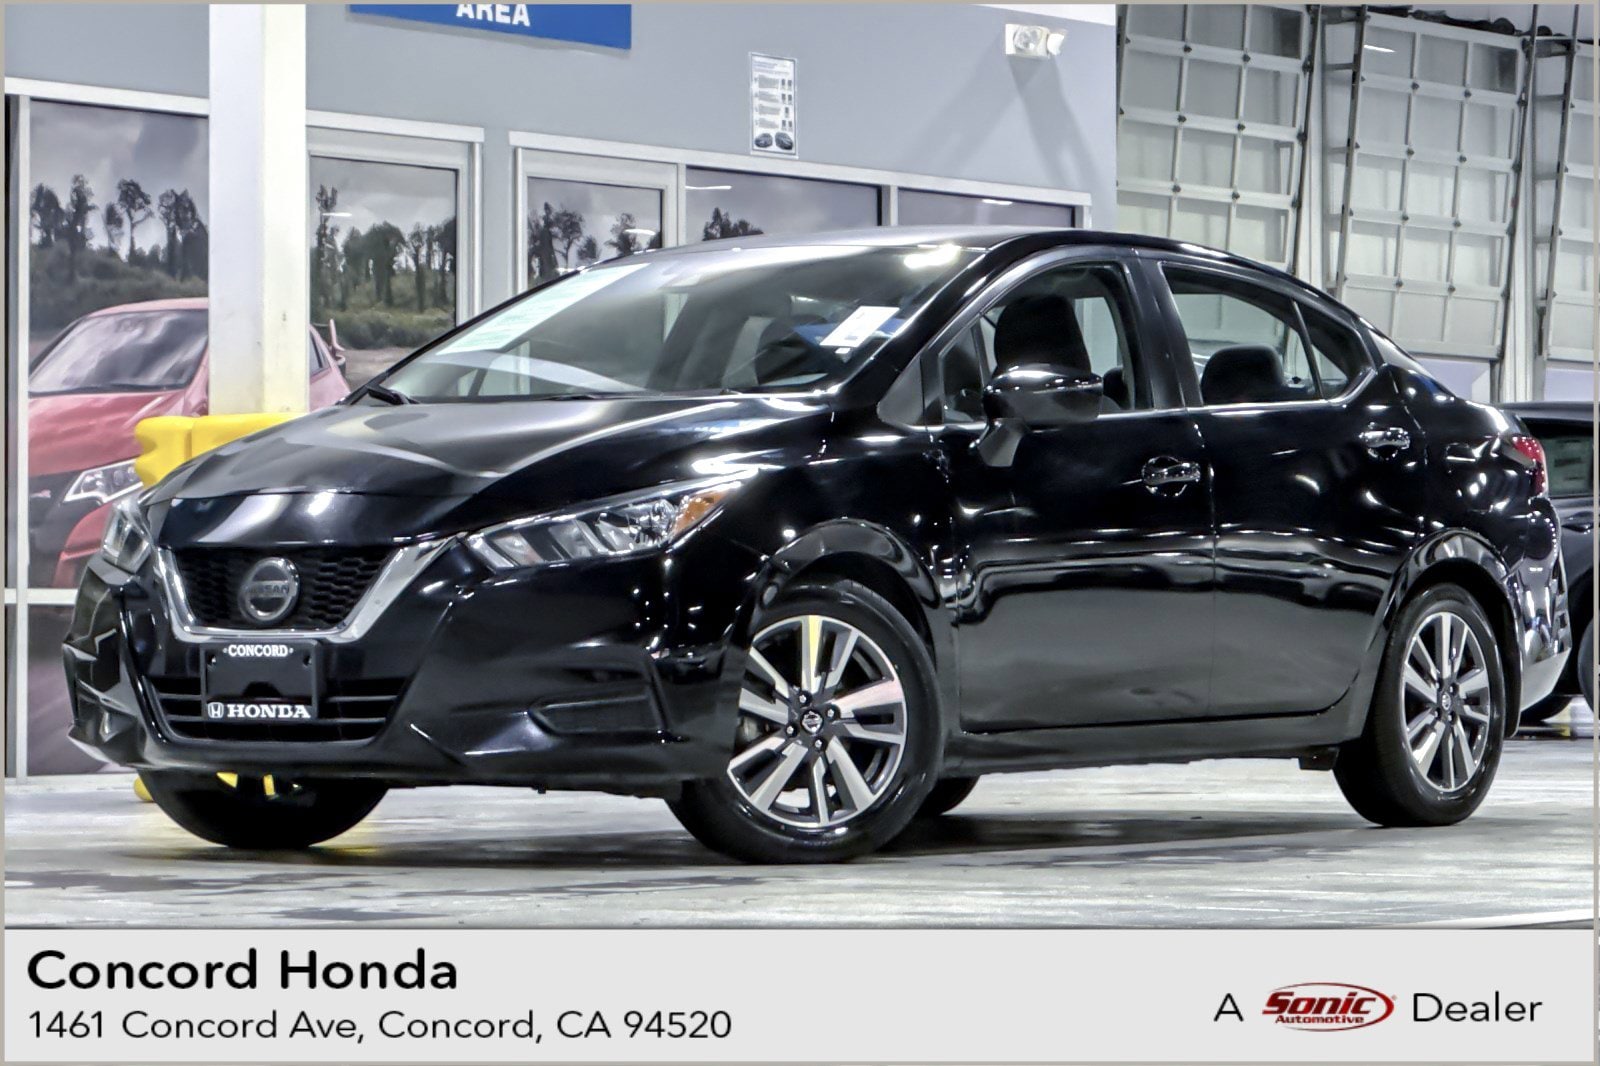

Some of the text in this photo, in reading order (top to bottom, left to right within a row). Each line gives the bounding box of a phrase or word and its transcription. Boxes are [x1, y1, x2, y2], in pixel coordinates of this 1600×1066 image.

[456, 4, 530, 27] AREA
[247, 584, 290, 596] SAN
[228, 644, 288, 657] CONCORD
[227, 703, 311, 718] HONDA
